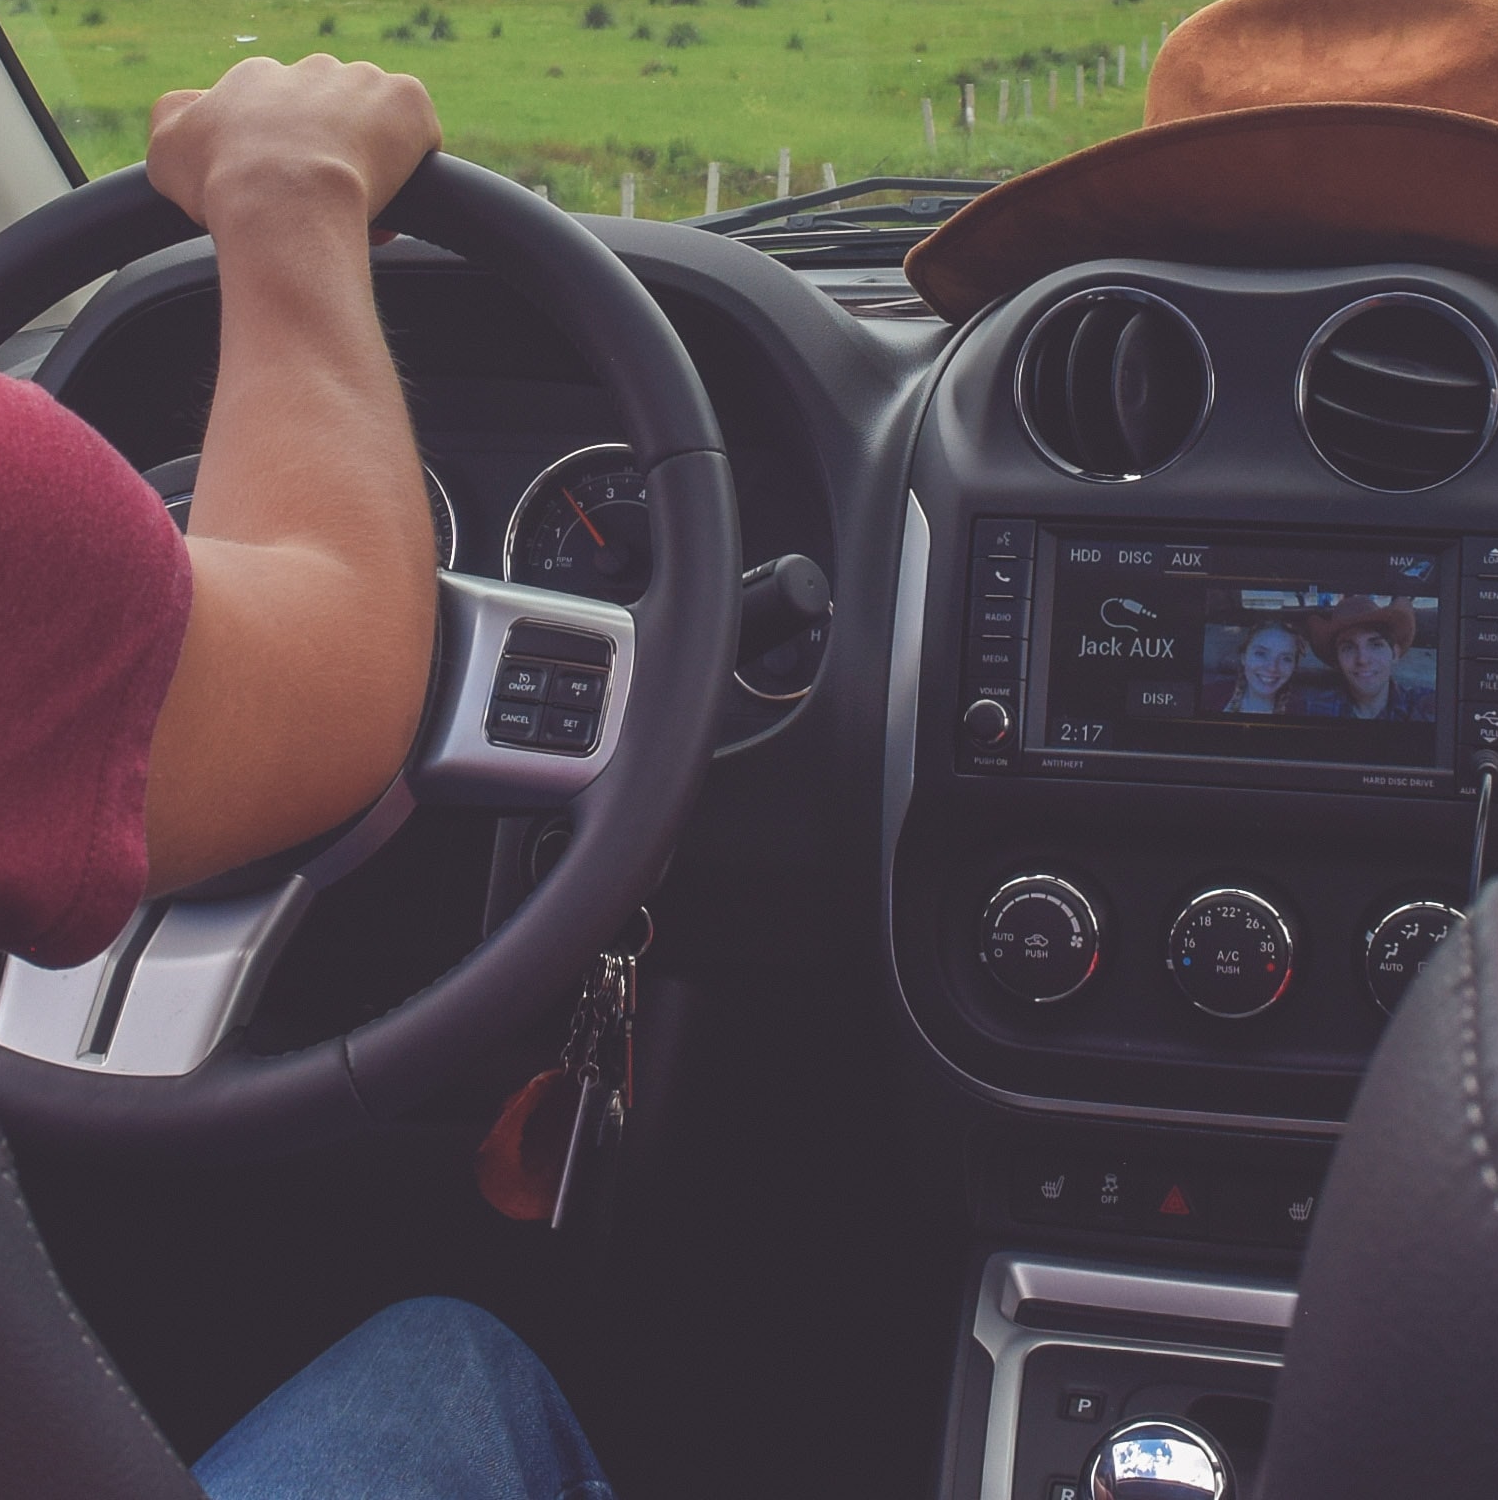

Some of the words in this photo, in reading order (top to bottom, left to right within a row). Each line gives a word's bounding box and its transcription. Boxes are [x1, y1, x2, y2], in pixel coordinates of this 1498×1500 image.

[606, 487, 615, 499] 3
[638, 489, 647, 500] 4
[1070, 549, 1102, 562] HDD
[1118, 550, 1153, 565] DISC
[1171, 553, 1203, 566] AUX
[1389, 556, 1414, 567] NAV
[544, 559, 553, 570] 0
[984, 613, 1012, 622] RADIO
[811, 629, 821, 642] H
[1078, 635, 1122, 658] Jack
[1129, 637, 1175, 659] AUX
[982, 654, 1009, 663] MEDIA
[571, 682, 588, 691] RES
[979, 687, 1011, 696] VOLUME
[1142, 692, 1177, 706] DISP.
[501, 713, 530, 724] CANCEL
[563, 719, 579, 728] SET
[1061, 723, 1103, 742] 2:17
[973, 757, 995, 766] PUSH
[996, 758, 1008, 767] ON
[1041, 759, 1084, 769] ANTITHEFT
[1362, 776, 1386, 785] HARD
[1388, 777, 1408, 787] DISC
[1409, 778, 1435, 788] DRIVE
[1460, 787, 1477, 795] AUX
[1221, 906, 1236, 918] 22
[1199, 915, 1212, 927] 18
[1245, 918, 1260, 929] 26
[991, 932, 1014, 942] AUTO
[1184, 937, 1196, 949] 16
[1260, 941, 1275, 952] 30
[1025, 949, 1048, 959] PUSH
[1216, 950, 1239, 962] A/C
[1216, 965, 1240, 974] PUSH
[1379, 962, 1404, 972] AUTO
[1100, 1194, 1118, 1204] OFF
[1077, 1398, 1092, 1412] P
[1061, 1488, 1075, 1500] R
